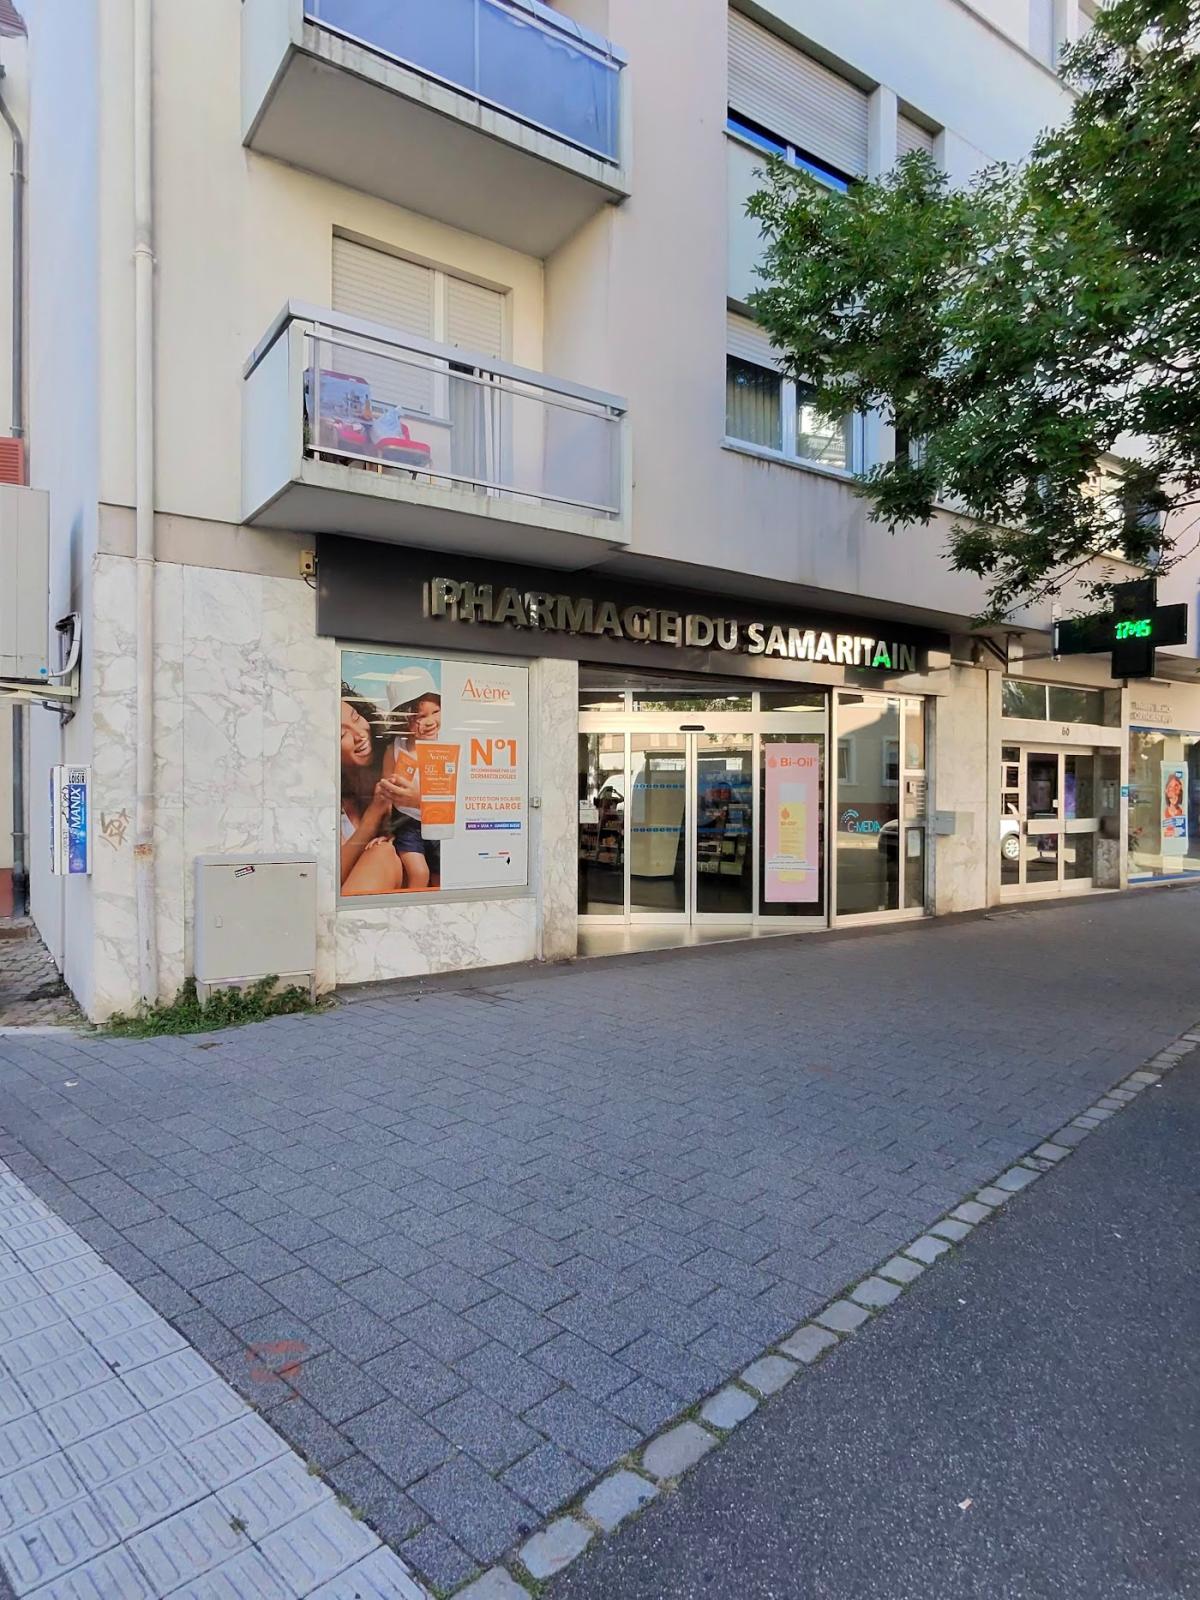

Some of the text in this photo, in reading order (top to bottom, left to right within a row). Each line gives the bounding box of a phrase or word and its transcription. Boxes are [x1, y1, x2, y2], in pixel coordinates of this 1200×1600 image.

[430, 576, 917, 672] PHARMACIE DU SAMARITAIN
[461, 677, 511, 700] Avène
[1061, 726, 1070, 737] 60
[471, 738, 517, 767] N°1
[70, 787, 81, 829] MANIX
[465, 802, 521, 811] ULTRA LARGE
